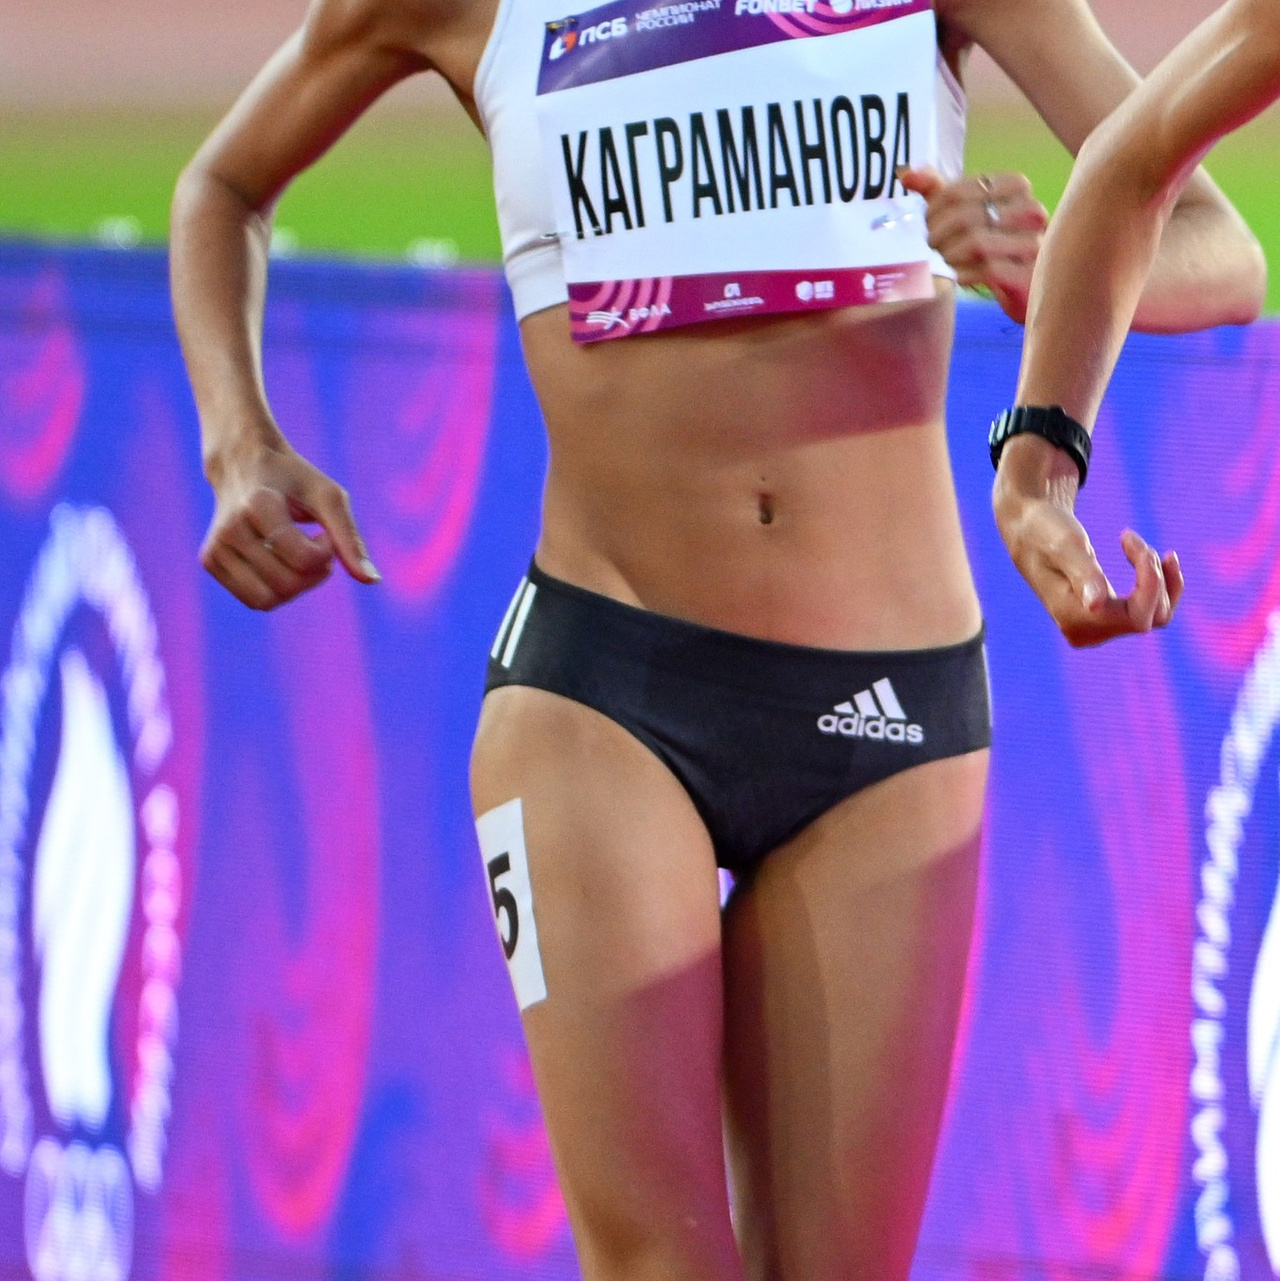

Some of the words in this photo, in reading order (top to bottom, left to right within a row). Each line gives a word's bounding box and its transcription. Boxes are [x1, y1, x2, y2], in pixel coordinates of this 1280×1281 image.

[578, 17, 629, 47] ПСБ
[560, 92, 912, 240] КАГРАМАНОВА
[816, 711, 923, 744] adidas
[487, 851, 520, 961] 5
